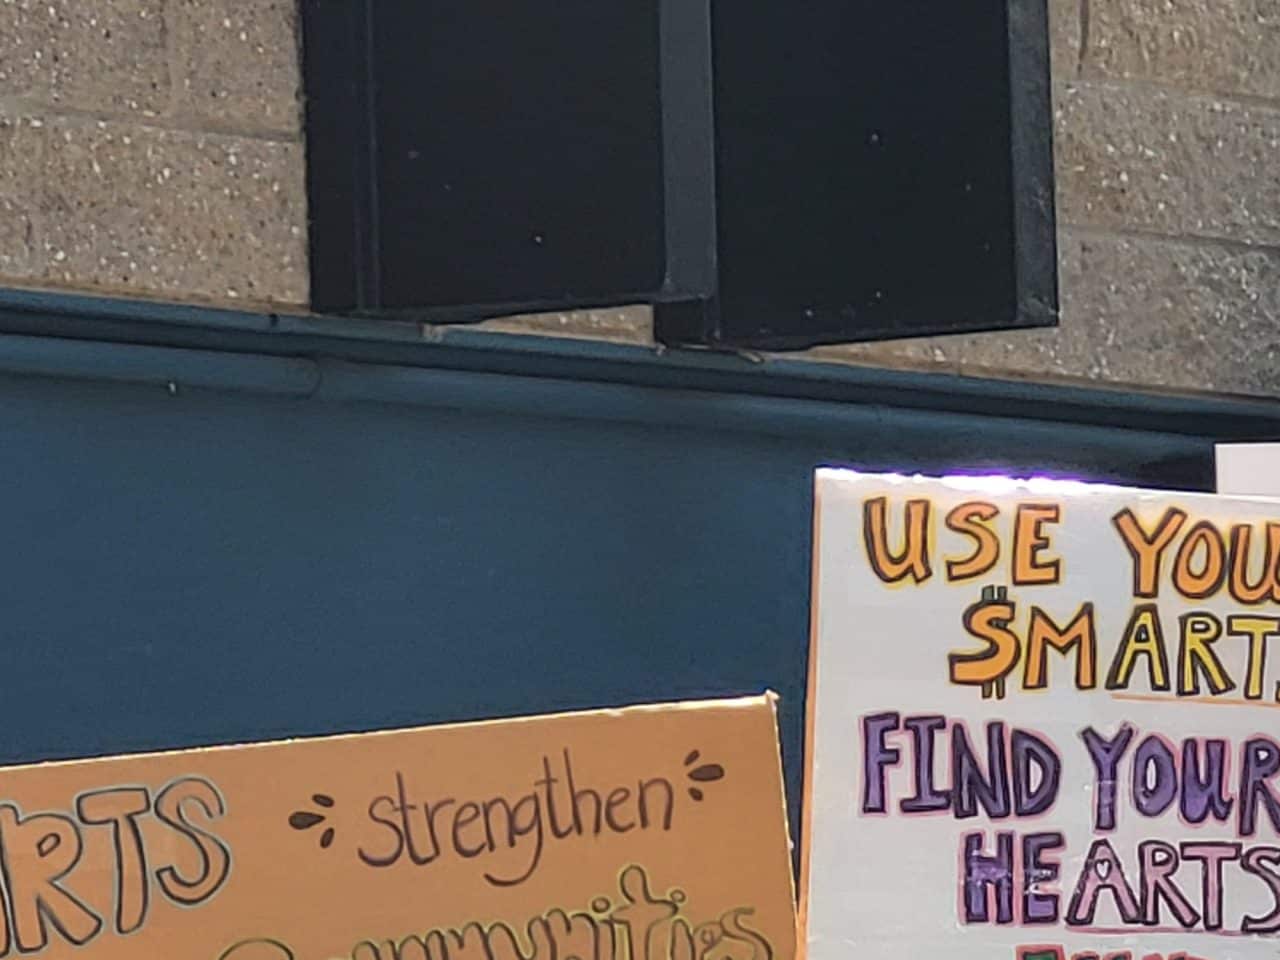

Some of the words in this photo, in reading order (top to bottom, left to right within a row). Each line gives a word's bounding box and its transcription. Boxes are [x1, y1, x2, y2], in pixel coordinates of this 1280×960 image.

[863, 497, 1061, 585] USE
[357, 749, 676, 886] strengthen
[861, 712, 1061, 818] FIND
[0, 777, 230, 957] RTS
